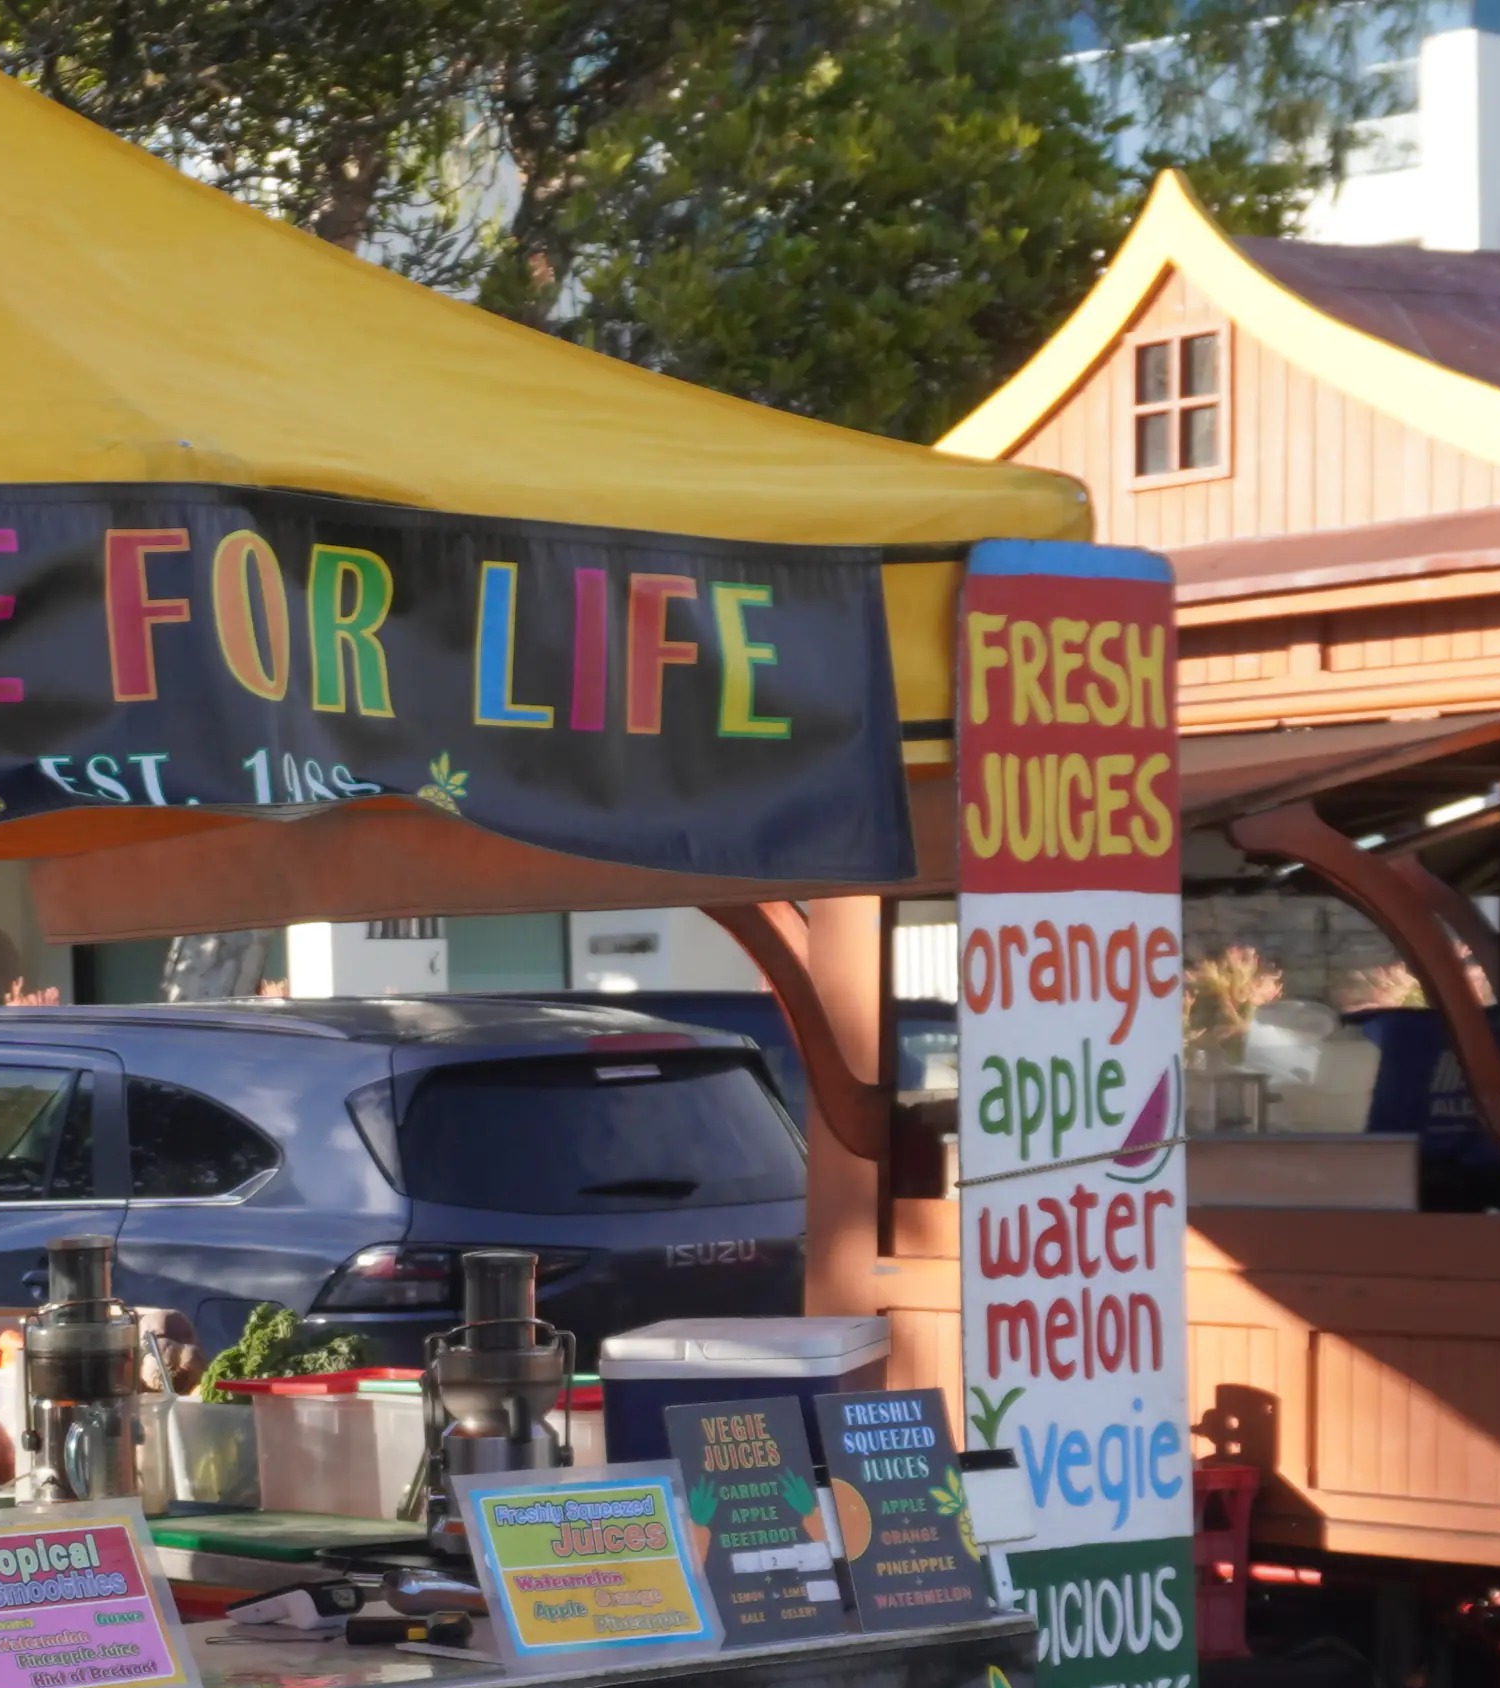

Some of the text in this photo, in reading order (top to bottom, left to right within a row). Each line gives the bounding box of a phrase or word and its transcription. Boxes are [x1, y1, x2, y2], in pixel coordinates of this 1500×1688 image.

[104, 527, 396, 720] FOR
[473, 560, 793, 740] LIFE
[967, 610, 1166, 729] FRESH
[965, 751, 1175, 863] JUICES
[962, 917, 1180, 1046] orange
[978, 1037, 1126, 1161] apple
[978, 1183, 1175, 1279] water
[666, 1237, 756, 1269] ISUZU
[987, 1286, 1163, 1381] melon
[843, 1400, 923, 1426] FRESHLY
[701, 1413, 771, 1444] VEGIE
[843, 1426, 936, 1456] SQUEEZED
[704, 1440, 781, 1473] JUICES
[861, 1454, 930, 1484] JUICES
[718, 1481, 779, 1501] CARROT
[494, 1494, 655, 1527] Freshly Squeezed
[731, 1506, 780, 1524] APPLE
[881, 1498, 927, 1515] APPLE
[552, 1519, 669, 1557] Juices
[718, 1526, 799, 1549] BEETROOT
[880, 1526, 940, 1546] ORANGE
[876, 1555, 957, 1577] PINEAPPLE
[514, 1570, 625, 1593] Watermelon
[534, 1587, 664, 1622] Apple Orange
[874, 1586, 972, 1610] WATERMELON
[94, 1609, 145, 1627] Guava
[592, 1608, 692, 1634] Pineapple
[15, 1642, 141, 1670] Pineapple Juice
[31, 1660, 159, 1688] Hint of Beetroot
